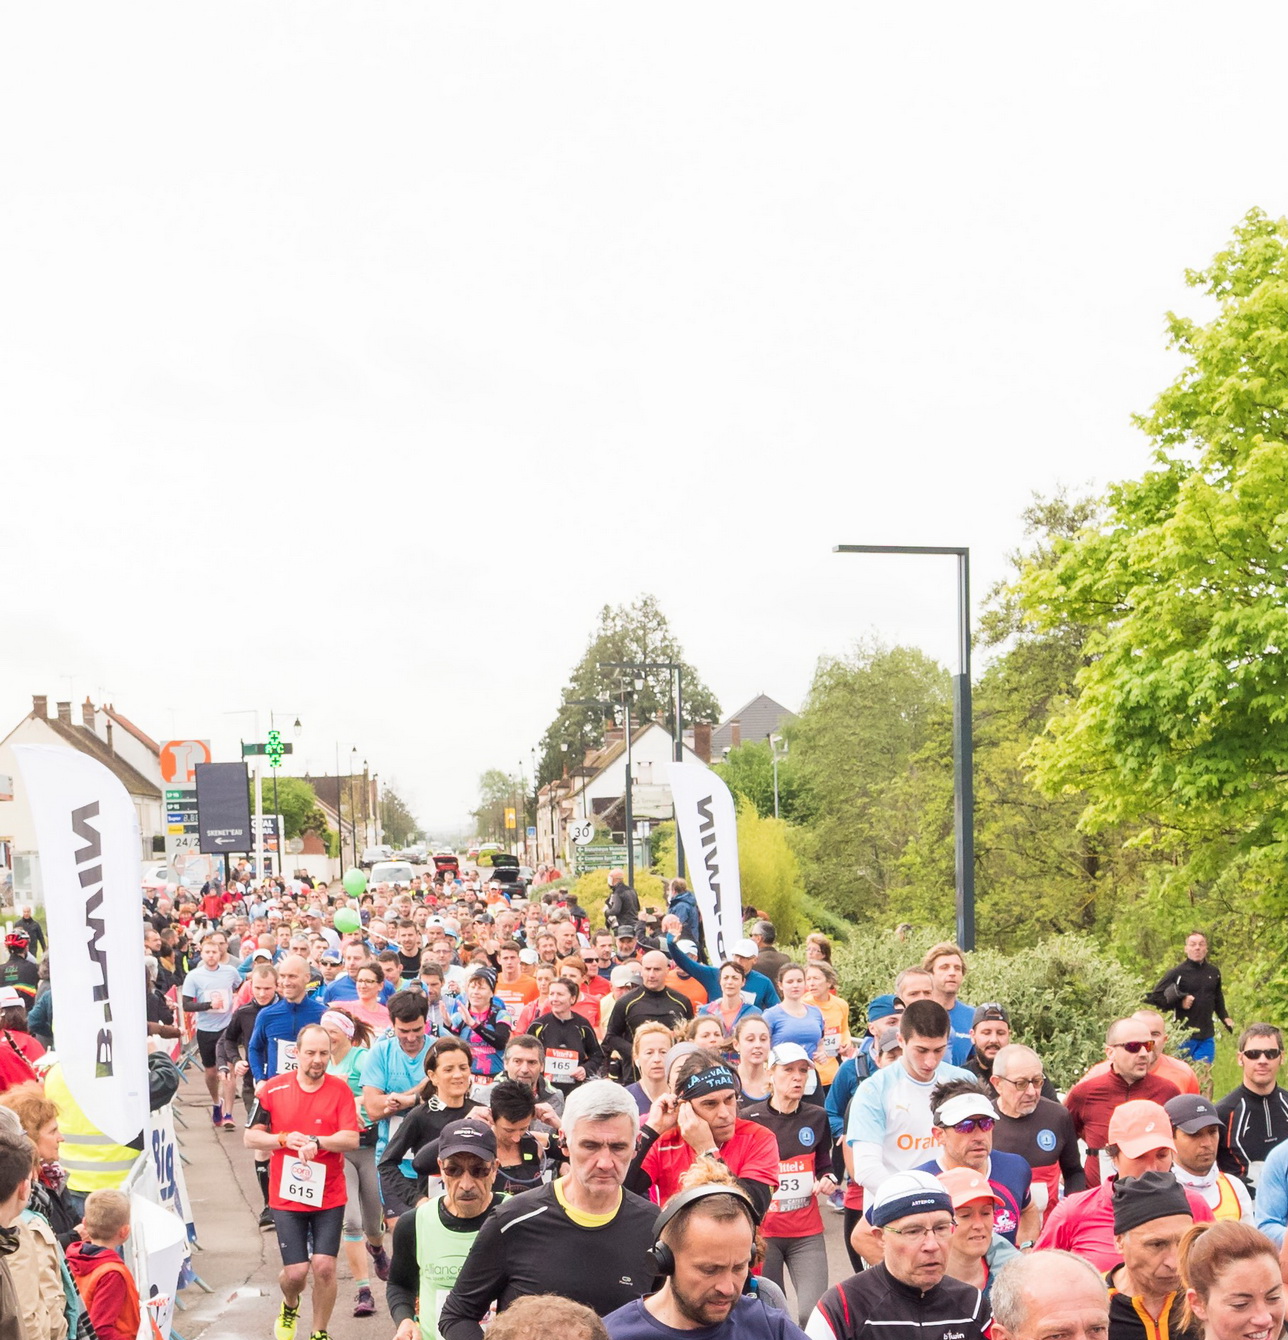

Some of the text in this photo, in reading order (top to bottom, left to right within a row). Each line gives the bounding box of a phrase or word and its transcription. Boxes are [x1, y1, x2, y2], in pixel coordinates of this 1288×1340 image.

[575, 827, 589, 837] 30
[551, 1061, 570, 1070] 165
[289, 1184, 314, 1198] 615
